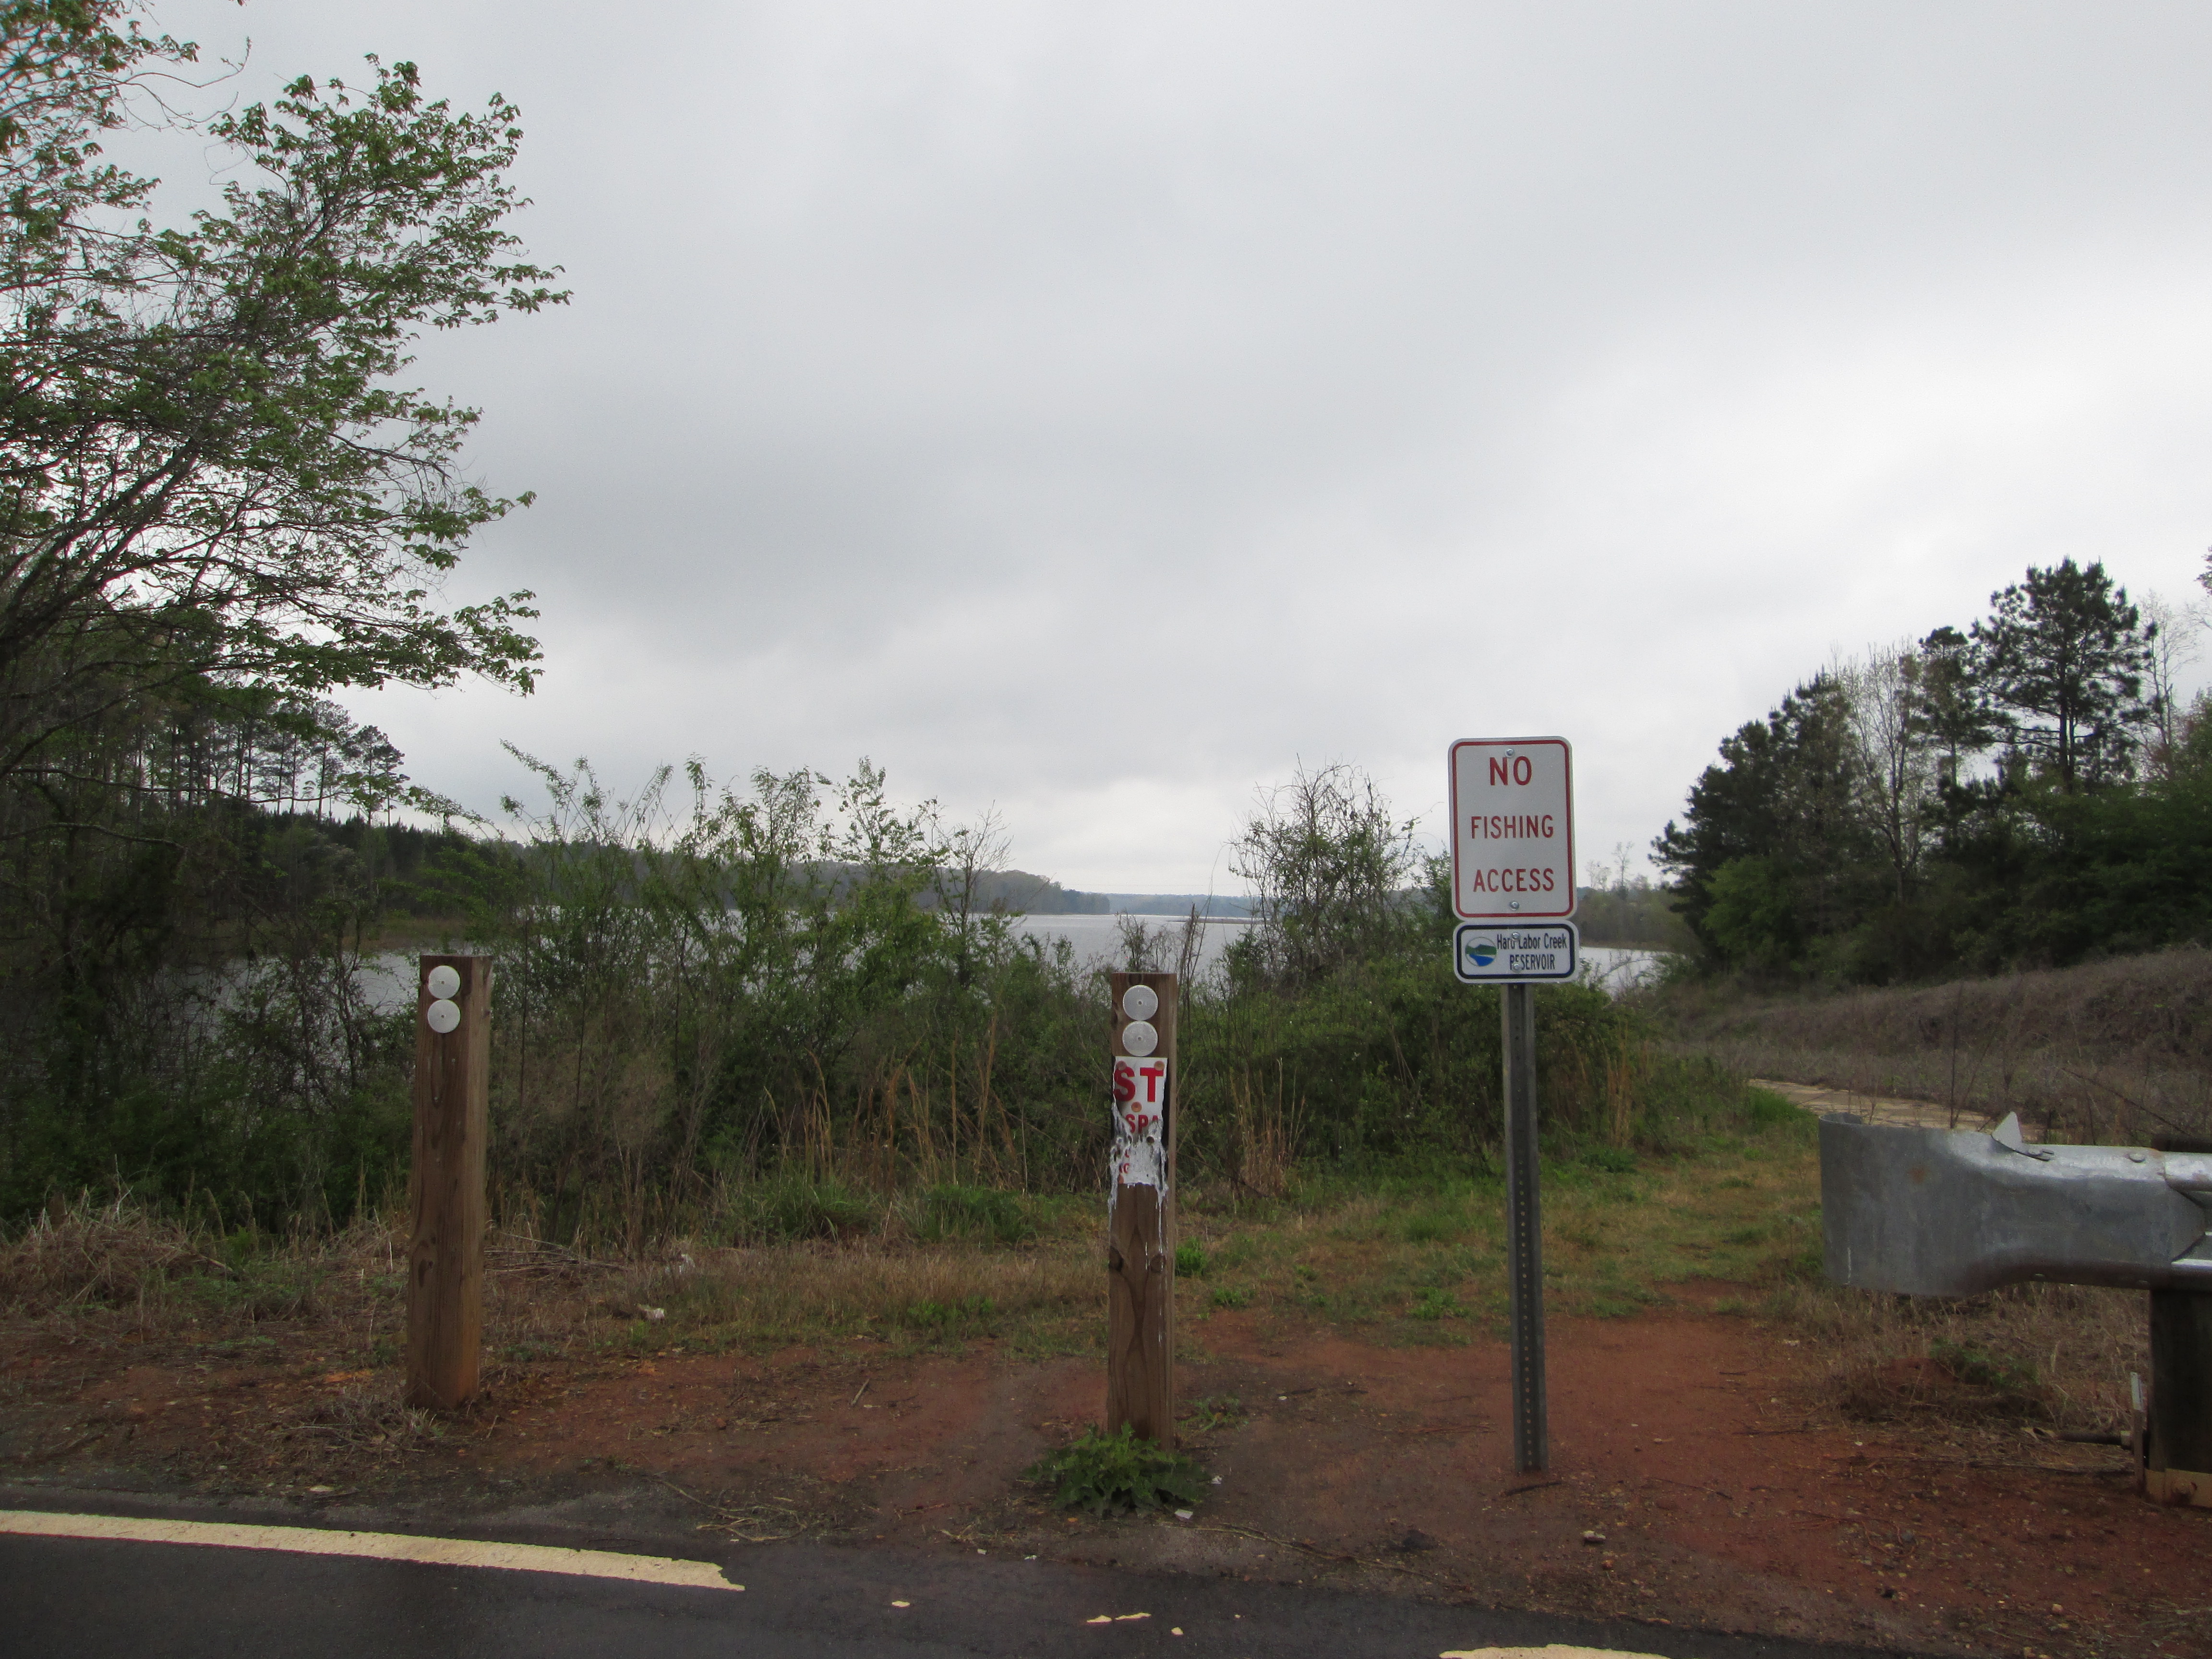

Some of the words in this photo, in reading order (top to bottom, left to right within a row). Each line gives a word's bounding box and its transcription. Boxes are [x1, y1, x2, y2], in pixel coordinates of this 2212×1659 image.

[1490, 756, 1532, 786] NO
[1471, 815, 1554, 839] FISHING
[1473, 868, 1554, 892] ACCESS
[1497, 934, 1515, 950] Hard
[1519, 934, 1540, 949] Labor
[1544, 933, 1568, 949] Creek
[1510, 954, 1555, 970] RESERVOIR
